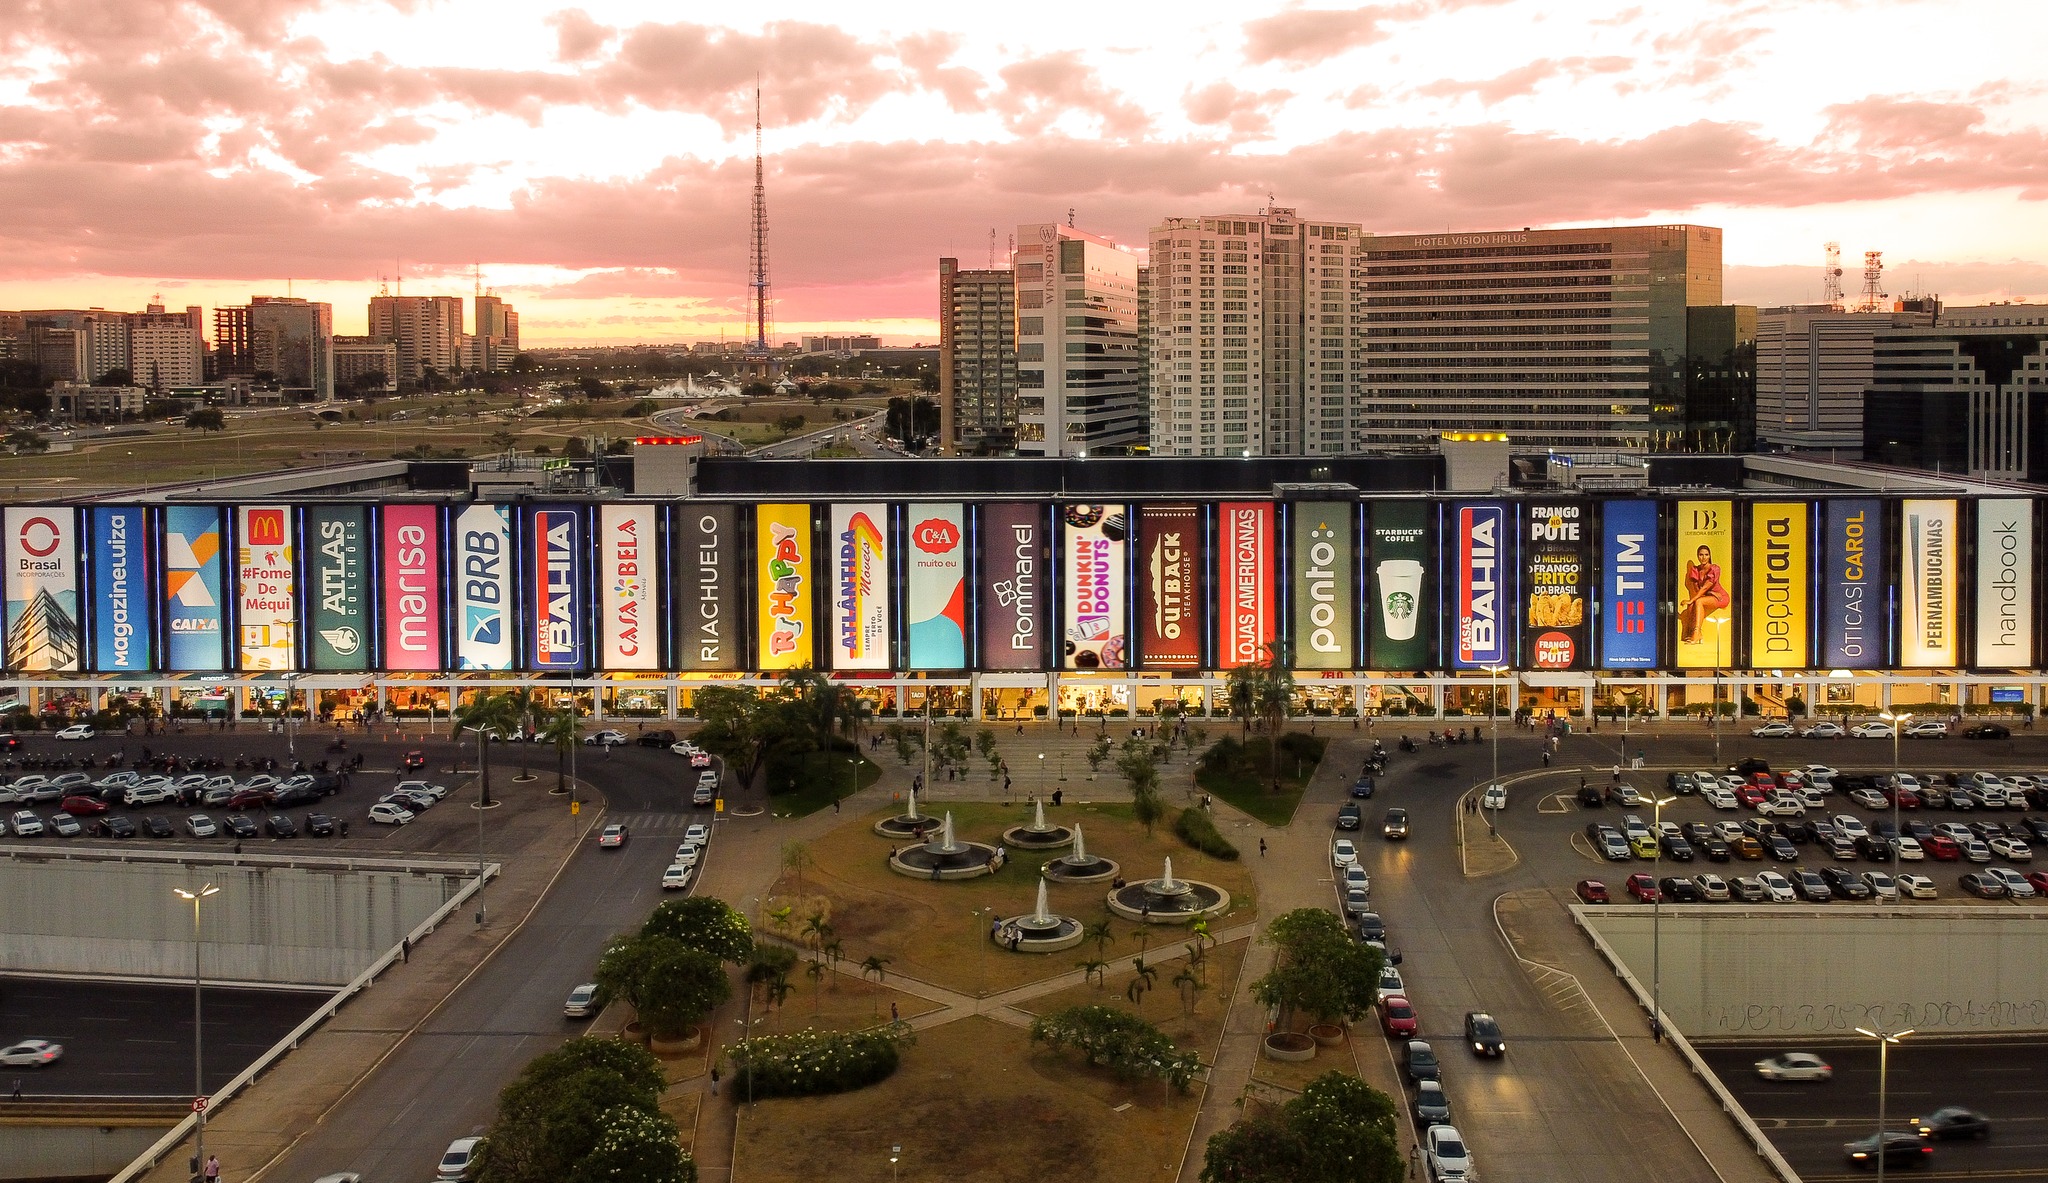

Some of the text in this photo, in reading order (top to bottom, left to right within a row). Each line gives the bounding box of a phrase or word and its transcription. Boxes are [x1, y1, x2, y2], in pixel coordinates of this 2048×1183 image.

[1414, 233, 1528, 247] HOTEL VISION HPLUS
[1045, 244, 1055, 304] WINDSOR
[1532, 506, 1580, 518] FRANGO
[921, 528, 952, 544] C&A
[1531, 522, 1580, 541] POTE
[20, 557, 61, 570] Brasal
[242, 567, 292, 579] #Fome
[321, 521, 346, 616] ATLAS
[346, 521, 358, 615] COLCHÕES
[465, 530, 501, 605] BRB
[917, 559, 957, 568] muito eu
[1094, 539, 1110, 614] DONUTS
[1533, 564, 1579, 573] FRANGO
[1534, 554, 1578, 564] O MELHOR
[1616, 534, 1645, 596] TIM
[258, 583, 278, 594] De
[397, 525, 428, 652] marisa
[547, 521, 572, 654] BAHIA
[616, 518, 639, 657] CASA BELA
[699, 514, 720, 662] RIACHUELO
[837, 529, 857, 650] ATLÂNTIDA
[1011, 524, 1034, 650] Rommanel
[1164, 532, 1181, 640] OUTBACK
[1238, 508, 1257, 663] LOJAS AMERICANAS
[1471, 517, 1495, 651] BAHIA
[1534, 572, 1579, 585] FRITO
[1534, 586, 1578, 595] DO BRASIL
[1766, 517, 1793, 654] peçarara
[1927, 518, 1943, 649] PERNAMBUCANAS
[1992, 520, 2018, 647] handbook
[245, 597, 291, 613] Méqui
[171, 618, 219, 631] CAIXA
[540, 618, 550, 653] CASAS
[878, 621, 884, 633] DE
[1461, 616, 1472, 651] CASAS
[1539, 640, 1570, 649] FRANGO
[1539, 650, 1570, 663] POTE
